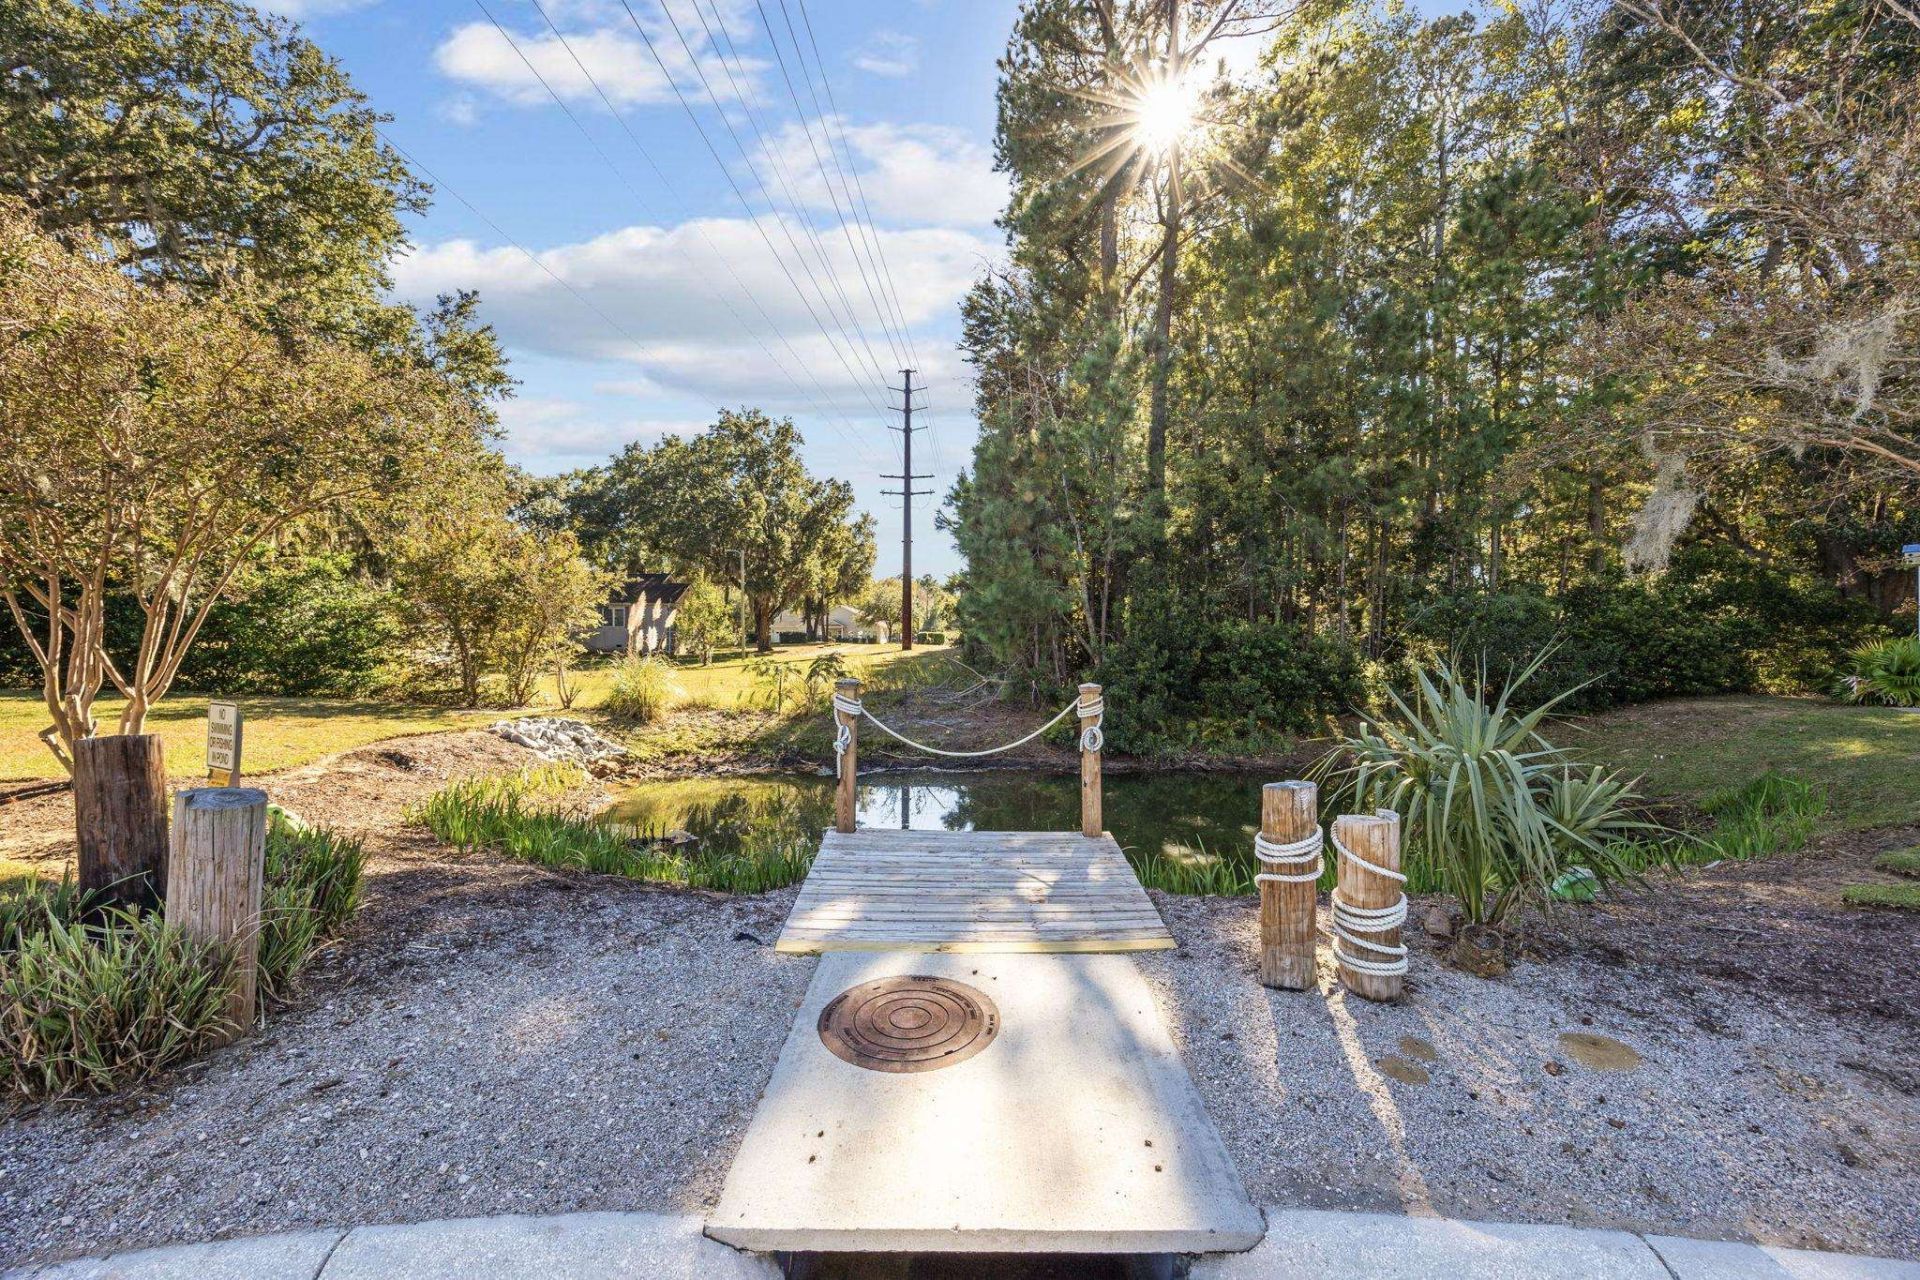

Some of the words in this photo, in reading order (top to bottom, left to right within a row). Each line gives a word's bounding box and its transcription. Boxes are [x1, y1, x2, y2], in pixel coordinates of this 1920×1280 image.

[211, 722, 232, 736] SWIMMING
[209, 736, 215, 748] OR
[215, 738, 233, 751] FISHING
[216, 752, 229, 765] POND
